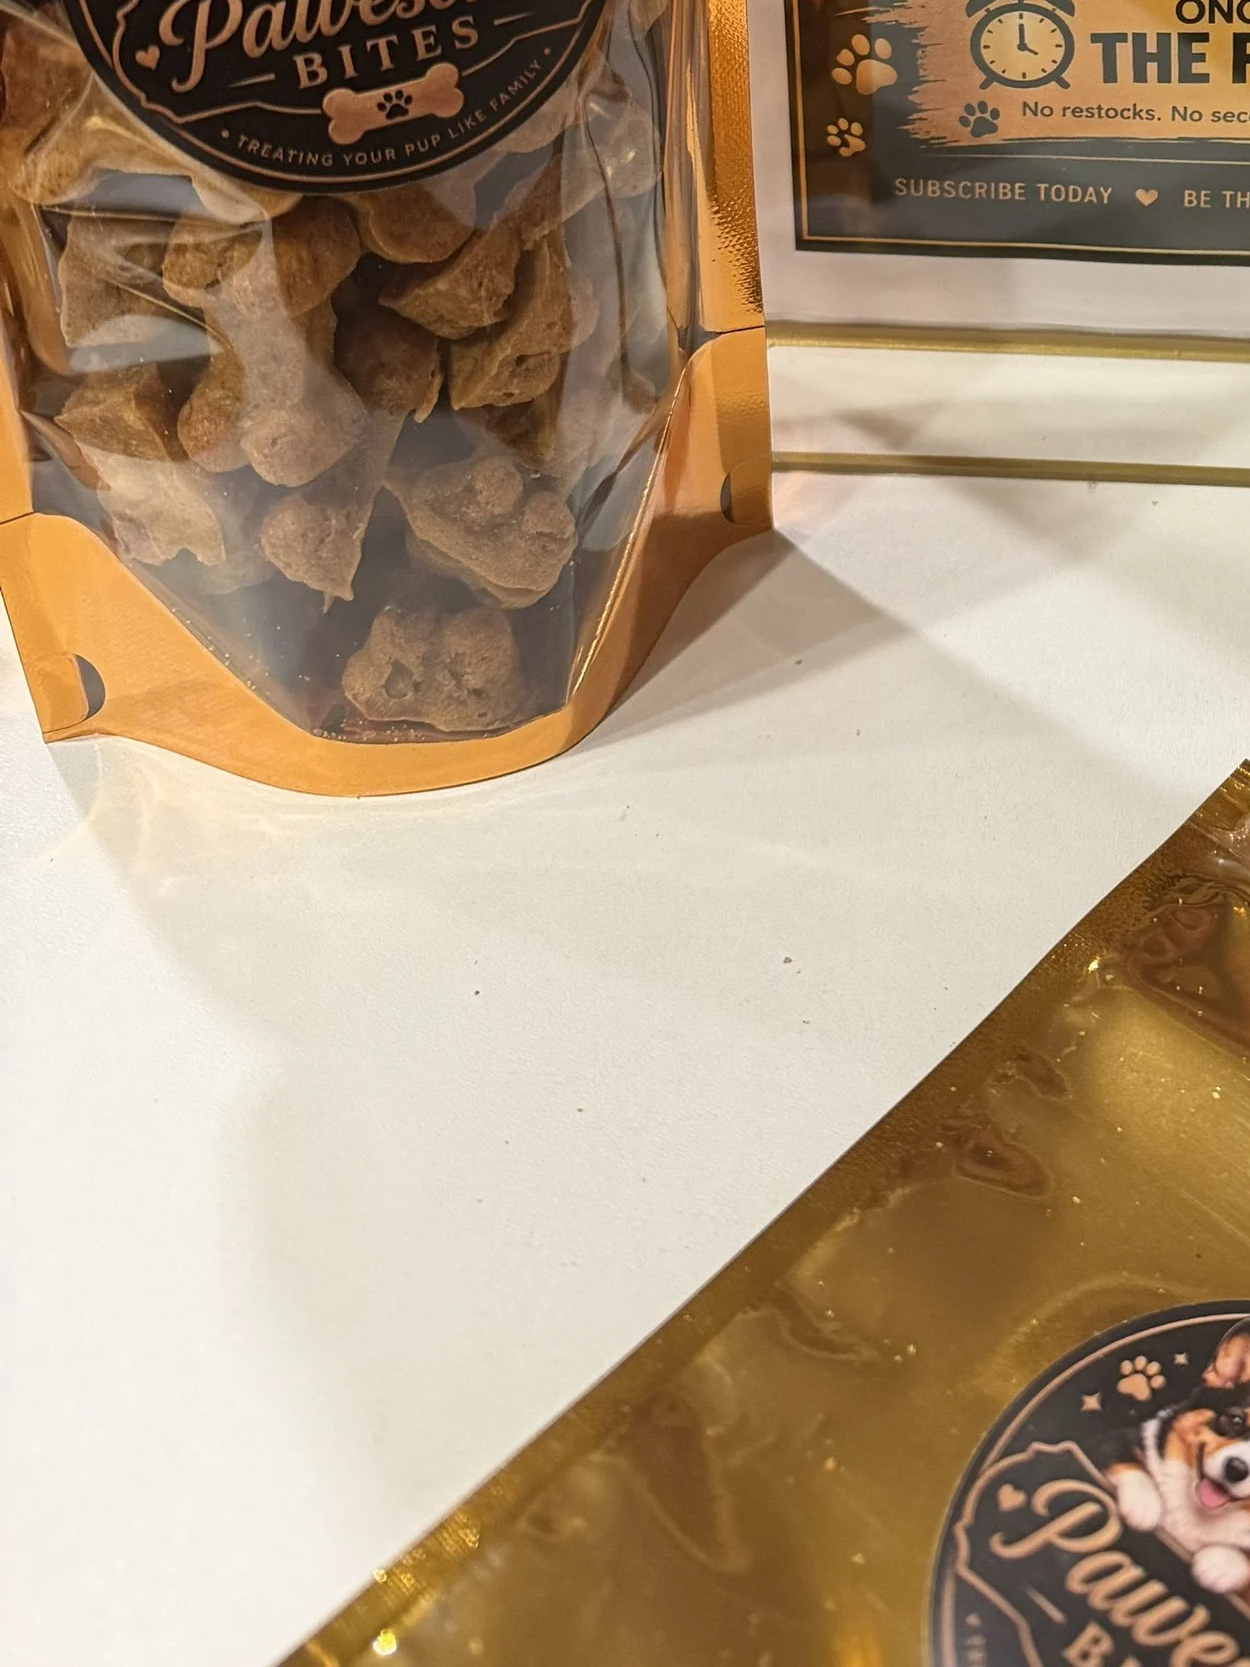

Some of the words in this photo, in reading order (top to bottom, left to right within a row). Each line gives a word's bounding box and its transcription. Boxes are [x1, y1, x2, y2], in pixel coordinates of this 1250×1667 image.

[293, 15, 481, 90] BITES
[1090, 32, 1210, 85] THE
[236, 134, 335, 168] TREATING
[343, 149, 397, 166] YOUR
[404, 134, 442, 158] PUP
[448, 109, 486, 140] LIKE
[489, 58, 543, 111] FAMILY
[1022, 100, 1054, 118] No
[1061, 103, 1162, 122] restocks.
[1171, 106, 1204, 123] No
[895, 179, 1026, 201] SUBSCRIBE
[1036, 183, 1113, 204] TODAY
[1184, 190, 1211, 208] BE
